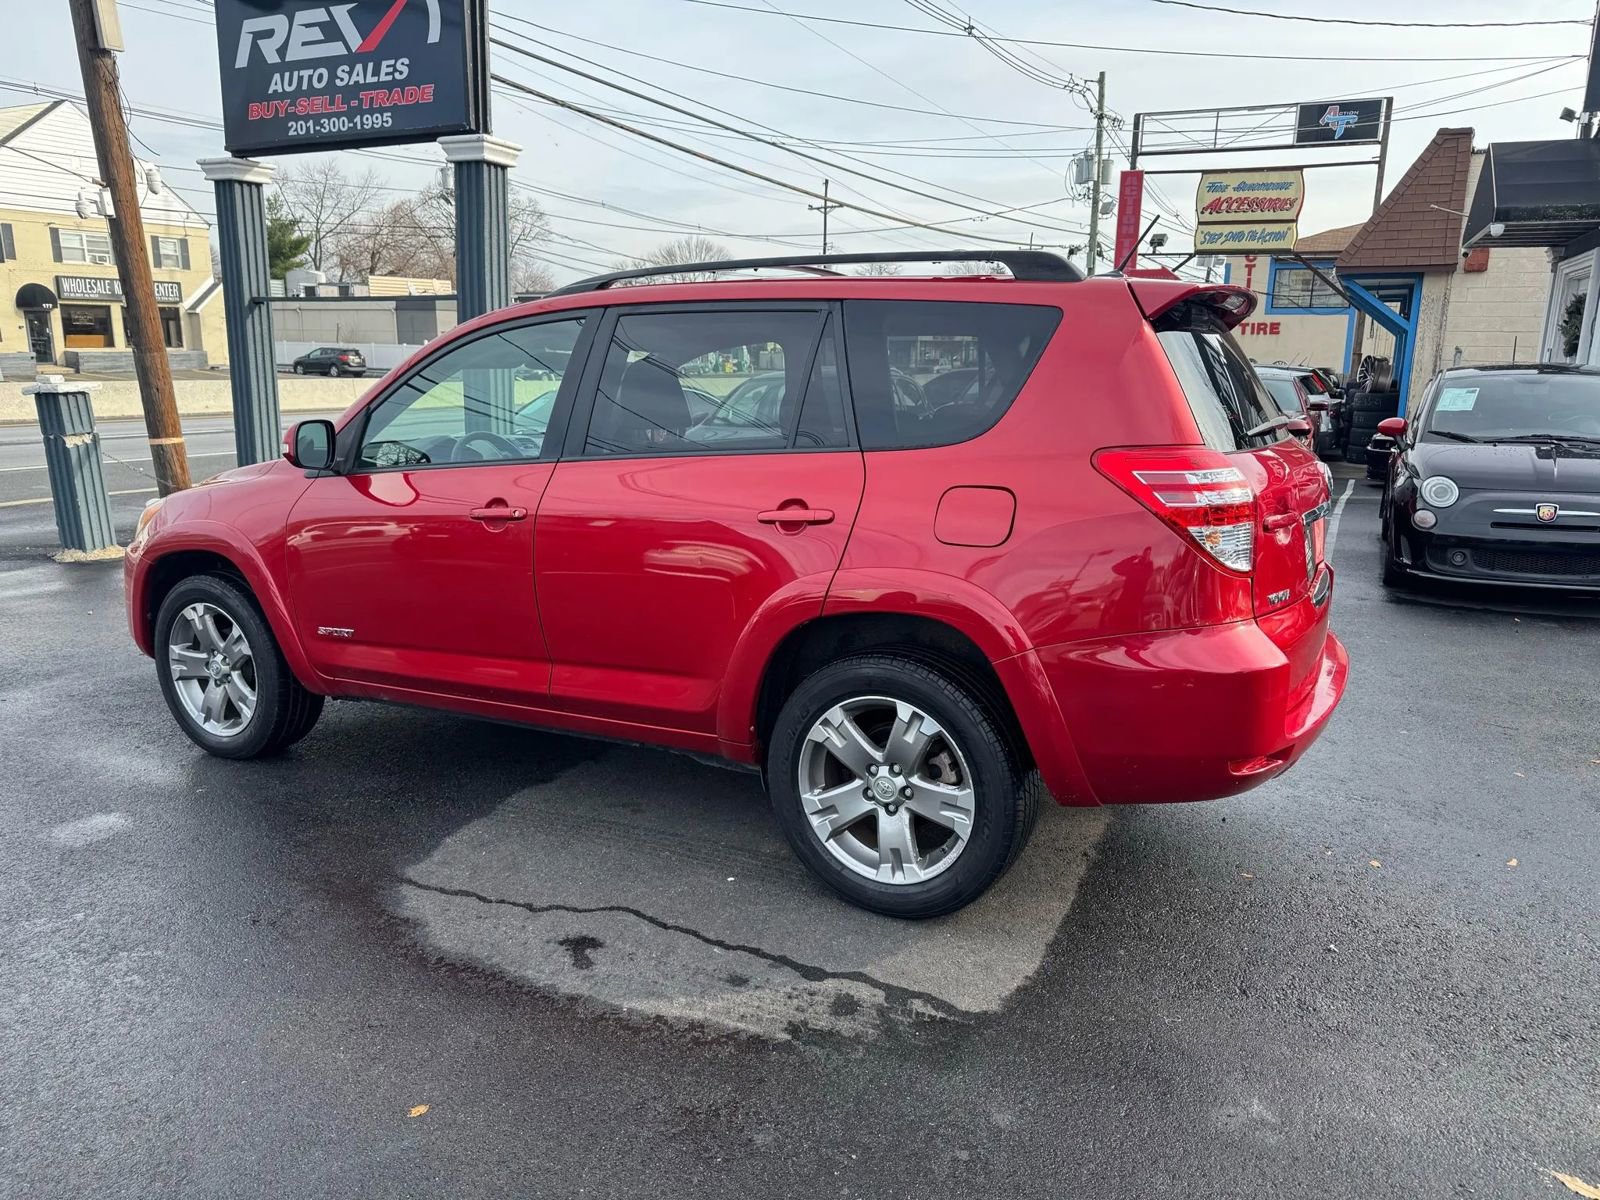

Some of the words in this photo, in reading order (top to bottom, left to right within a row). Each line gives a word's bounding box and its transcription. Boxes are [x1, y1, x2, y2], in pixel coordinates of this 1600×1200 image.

[268, 67, 329, 94] AUTO
[335, 57, 410, 88] SALES
[287, 112, 393, 136] 201-300-1995
[1201, 196, 1298, 215] ACCESSORIES
[62, 278, 111, 294] WHOLESALE
[155, 283, 179, 297] ENTER
[1239, 322, 1281, 336] TIRE
